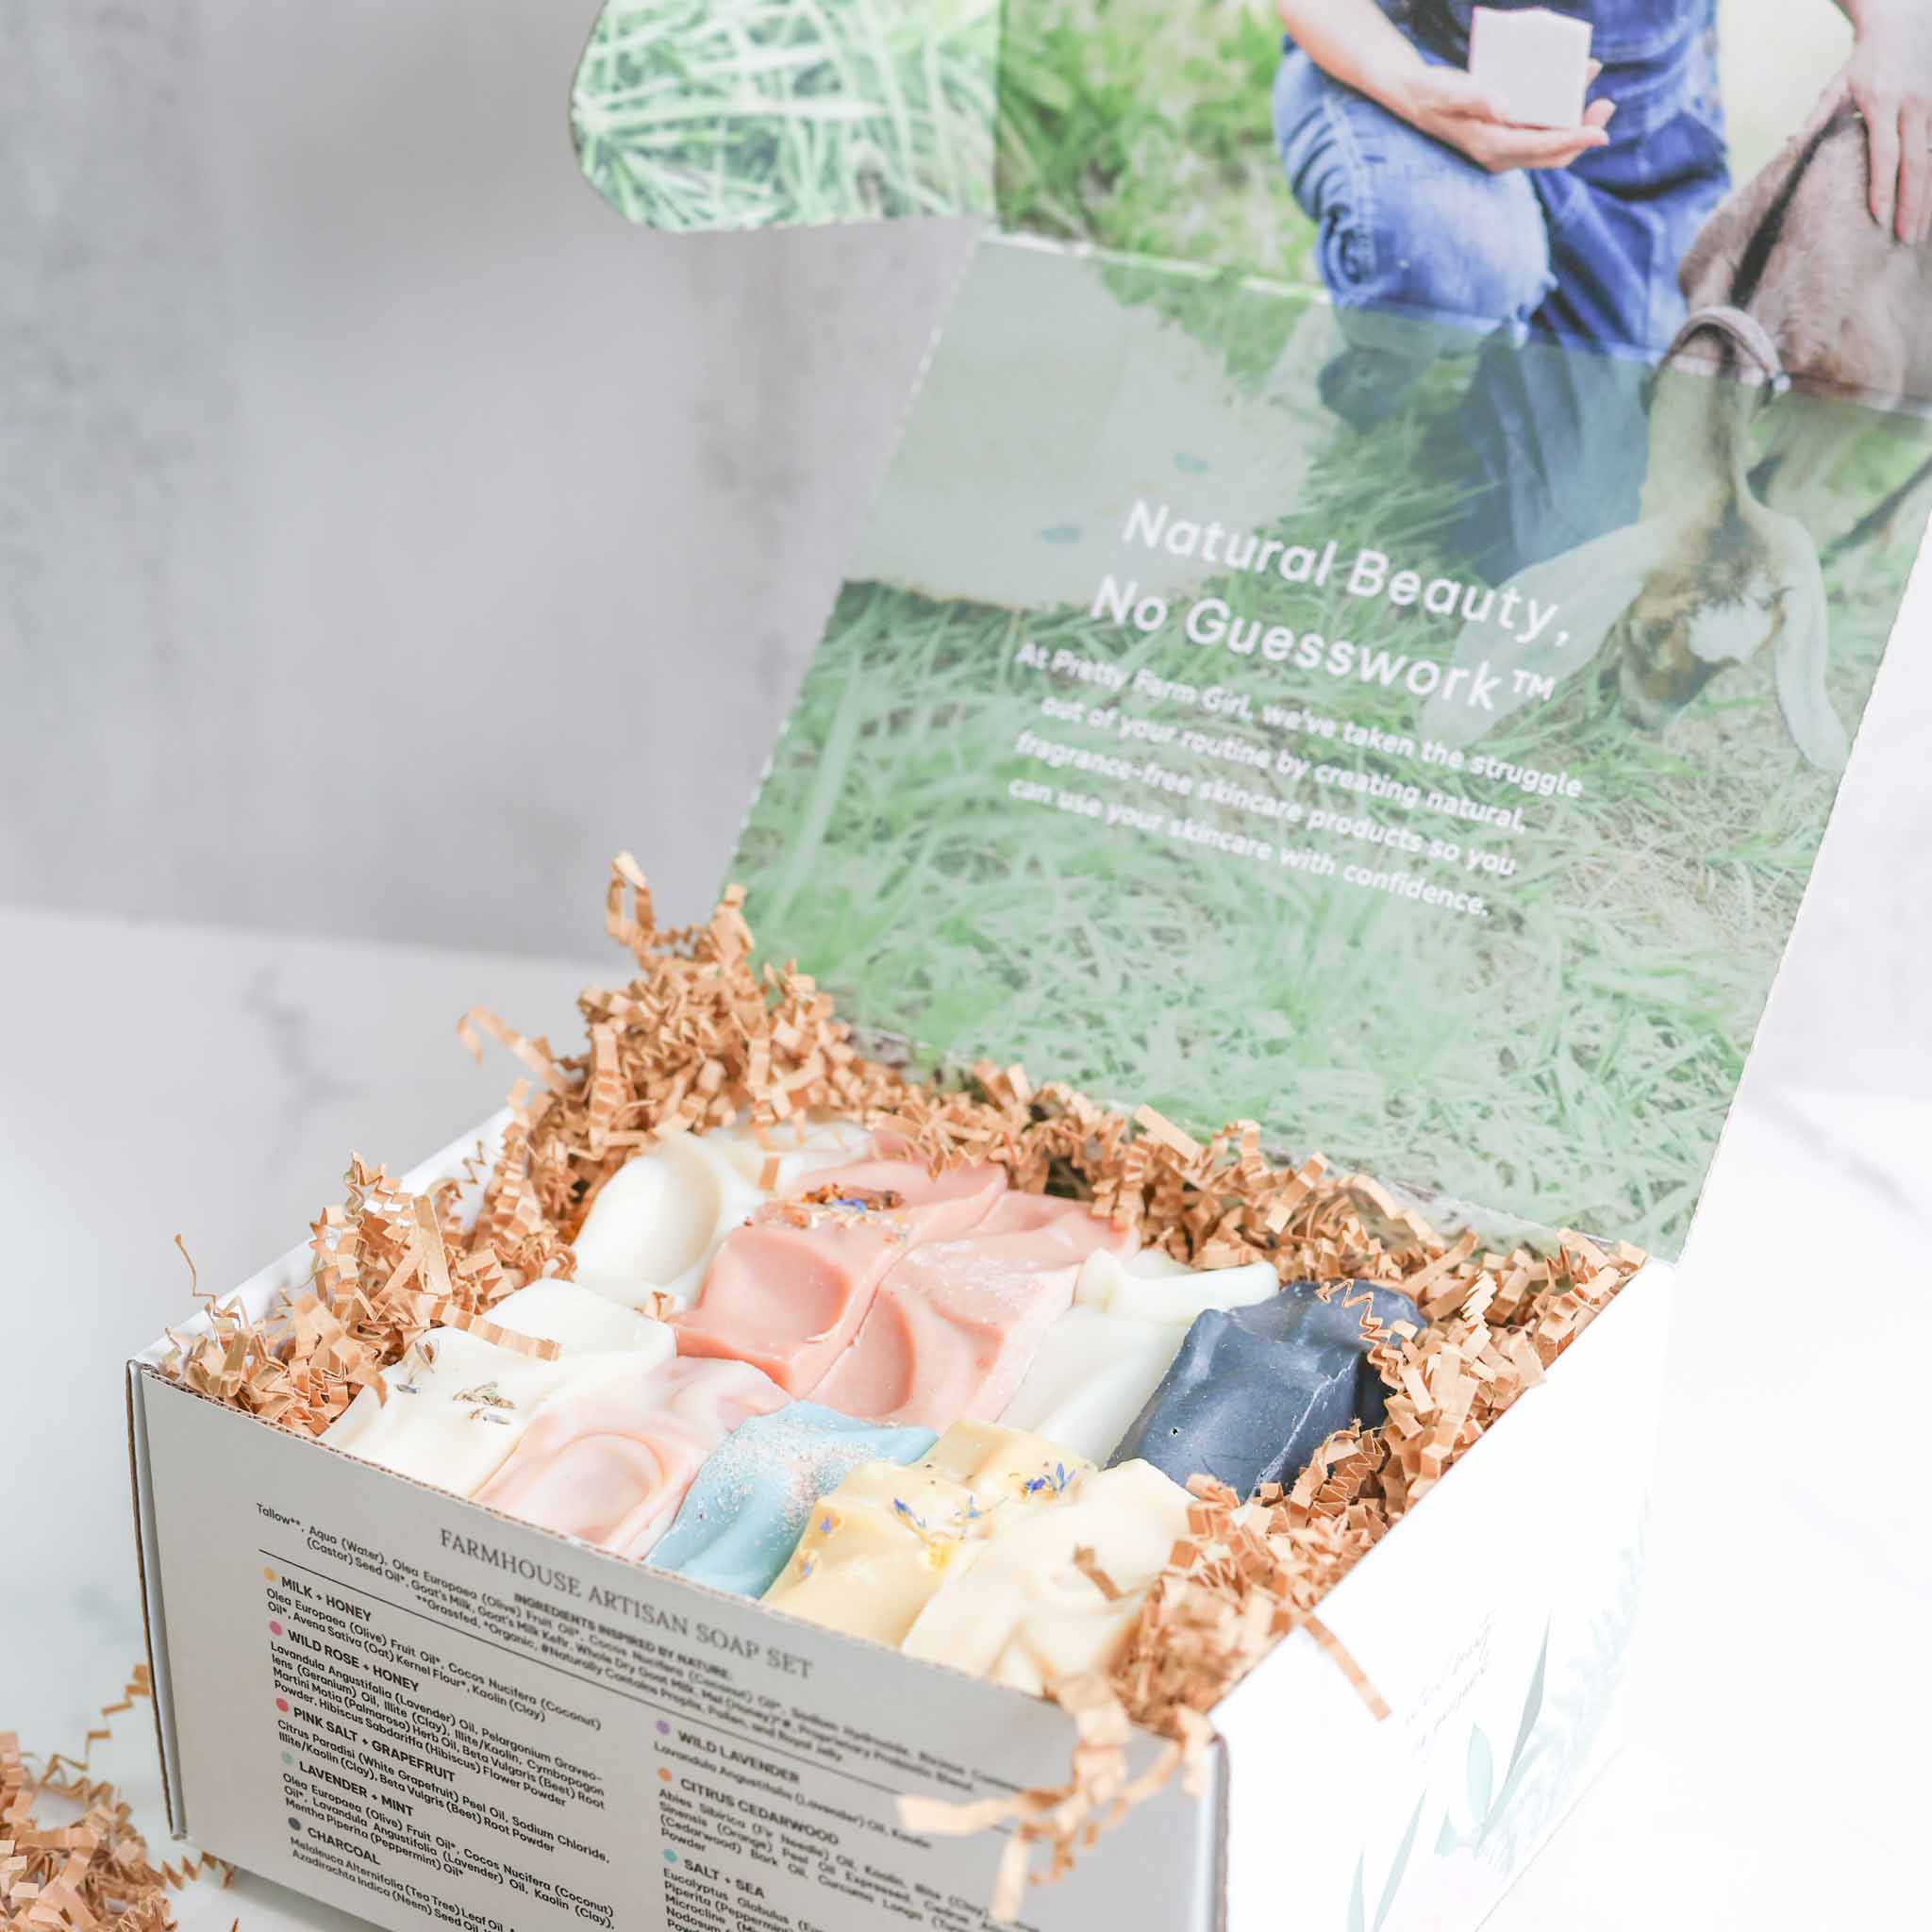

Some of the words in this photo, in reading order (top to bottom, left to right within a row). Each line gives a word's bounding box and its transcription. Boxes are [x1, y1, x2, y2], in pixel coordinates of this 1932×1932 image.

[1091, 575, 1168, 631] No
[1122, 499, 1338, 587] Natural
[1347, 549, 1570, 646] Beauty,
[1015, 642, 1048, 670] At
[1051, 649, 1129, 691] Pretty
[1133, 668, 1196, 704] Farm
[1201, 686, 1252, 722] Girl,
[1262, 705, 1336, 739] we've
[1342, 721, 1415, 756] taken
[1422, 740, 1463, 770] the
[1471, 755, 1584, 798] struggle
[1041, 696, 1083, 723] out
[1088, 708, 1119, 728] of
[1118, 716, 1177, 742] your
[1180, 730, 1271, 769] routine
[1275, 748, 1311, 779] by
[1314, 764, 1421, 809] creating
[1426, 790, 1524, 834] natural,
[1008, 778, 1052, 803] can
[1057, 791, 1103, 818] use
[1107, 804, 1164, 831] your
[1169, 818, 1272, 859] skincare
[1279, 846, 1336, 876] with
[1342, 863, 1490, 917] confidence.
[1016, 729, 1193, 795] fragrance-free
[1199, 780, 1303, 823] skincare
[1306, 810, 1423, 853] products
[1428, 840, 1459, 861] so
[1467, 848, 1516, 876] you
[280, 1575, 313, 1599] MILK
[325, 1593, 372, 1622] HONEY
[308, 1524, 338, 1545] Aqua
[391, 1557, 419, 1575] Olea
[422, 1569, 478, 1599] Europaea
[440, 1527, 581, 1596] FARMHOUSE
[588, 1585, 688, 1636] ARTISAN
[695, 1622, 759, 1658] SOAP
[764, 1647, 815, 1680] SET
[265, 1587, 292, 1607] Olea
[293, 1598, 346, 1629] Europaea
[348, 1621, 388, 1646] (Olive)
[389, 1637, 416, 1657] Fruit
[446, 1661, 485, 1685] Cocos
[487, 1676, 537, 1705] Nucifera
[539, 1697, 601, 1731] (Coconut)
[269, 1640, 325, 1672] Lavandula
[327, 1664, 392, 1700] Angustifolia
[393, 1690, 457, 1726] (Lavender)
[480, 1726, 551, 1763] Pelargonium
[553, 1756, 602, 1781] Graveo-
[286, 1628, 323, 1653] WILD
[323, 1643, 360, 1669] ROSE
[372, 1663, 419, 1692] HONEY
[291, 1610, 326, 1633] Avena
[325, 1624, 362, 1648] Sativa
[362, 1639, 394, 1663] (Oat)
[394, 1652, 431, 1676] Kernel
[471, 1683, 508, 1707] Kaolin
[508, 1697, 546, 1723] (Clay)
[270, 1652, 293, 1671] lens
[295, 1663, 358, 1699] (Geranium)
[382, 1698, 408, 1718] Illite
[525, 1757, 605, 1796] Cymbopogon
[272, 1665, 310, 1690] Martini
[310, 1681, 342, 1704] Motia
[342, 1695, 411, 1733] (Palmarosa)
[411, 1723, 440, 1743] Herb
[460, 1743, 490, 1764] Beta
[489, 1755, 537, 1783] Vulgaris
[537, 1774, 576, 1800] (Beet)
[576, 1790, 605, 1809] Root
[276, 1718, 309, 1740] Citrus
[310, 1732, 356, 1759] Paradisi
[357, 1751, 395, 1775] (White
[396, 1768, 459, 1804] Grapefruit)
[460, 1794, 487, 1813] Peel
[510, 1814, 555, 1840] Sodium
[292, 1706, 325, 1729] PINK
[325, 1720, 358, 1742] SALT
[370, 1739, 456, 1782] GRAPEFRUIT
[318, 1696, 364, 1725] Hibiscus
[364, 1716, 424, 1750] Sabdariffa
[424, 1740, 481, 1774] (Hibiscus)
[481, 1764, 521, 1789] Flower
[522, 1780, 566, 1807] Powder
[676, 1729, 717, 1754] WILD
[718, 1744, 800, 1784] LAVENDER
[277, 1730, 340, 1764] Illite/Kaolin
[378, 1772, 406, 1792] Beta
[406, 1783, 445, 1808] Vulgris
[444, 1799, 482, 1825] (Beet)
[482, 1815, 510, 1836] Root
[510, 1826, 555, 1853] Powder
[281, 1772, 308, 1790] Olea
[310, 1783, 362, 1814] Europaea
[364, 1806, 403, 1832] (Olive)
[405, 1823, 432, 1842] Fruit
[462, 1847, 500, 1871] Cocos
[502, 1862, 551, 1891] Nucifera
[553, 1883, 614, 1918] (Coconut)
[284, 1795, 325, 1821] Mentha
[325, 1812, 369, 1840] Piperita
[369, 1831, 441, 1871] (Peppermint)
[298, 1759, 368, 1798] LAVENDER
[379, 1793, 414, 1817] MINT
[679, 1777, 735, 1807] CITRUS
[736, 1799, 839, 1845] CEDARWOOD
[306, 1825, 381, 1866] CHARCOAL
[311, 1795, 368, 1827] Lavandula
[372, 1822, 438, 1857] Angustifolia
[441, 1849, 504, 1885] (Lavender)
[533, 1887, 570, 1910] Kaolin
[662, 1866, 729, 1901] Eucalyptus
[683, 1857, 720, 1881] SALT
[734, 1877, 765, 1899] SEA
